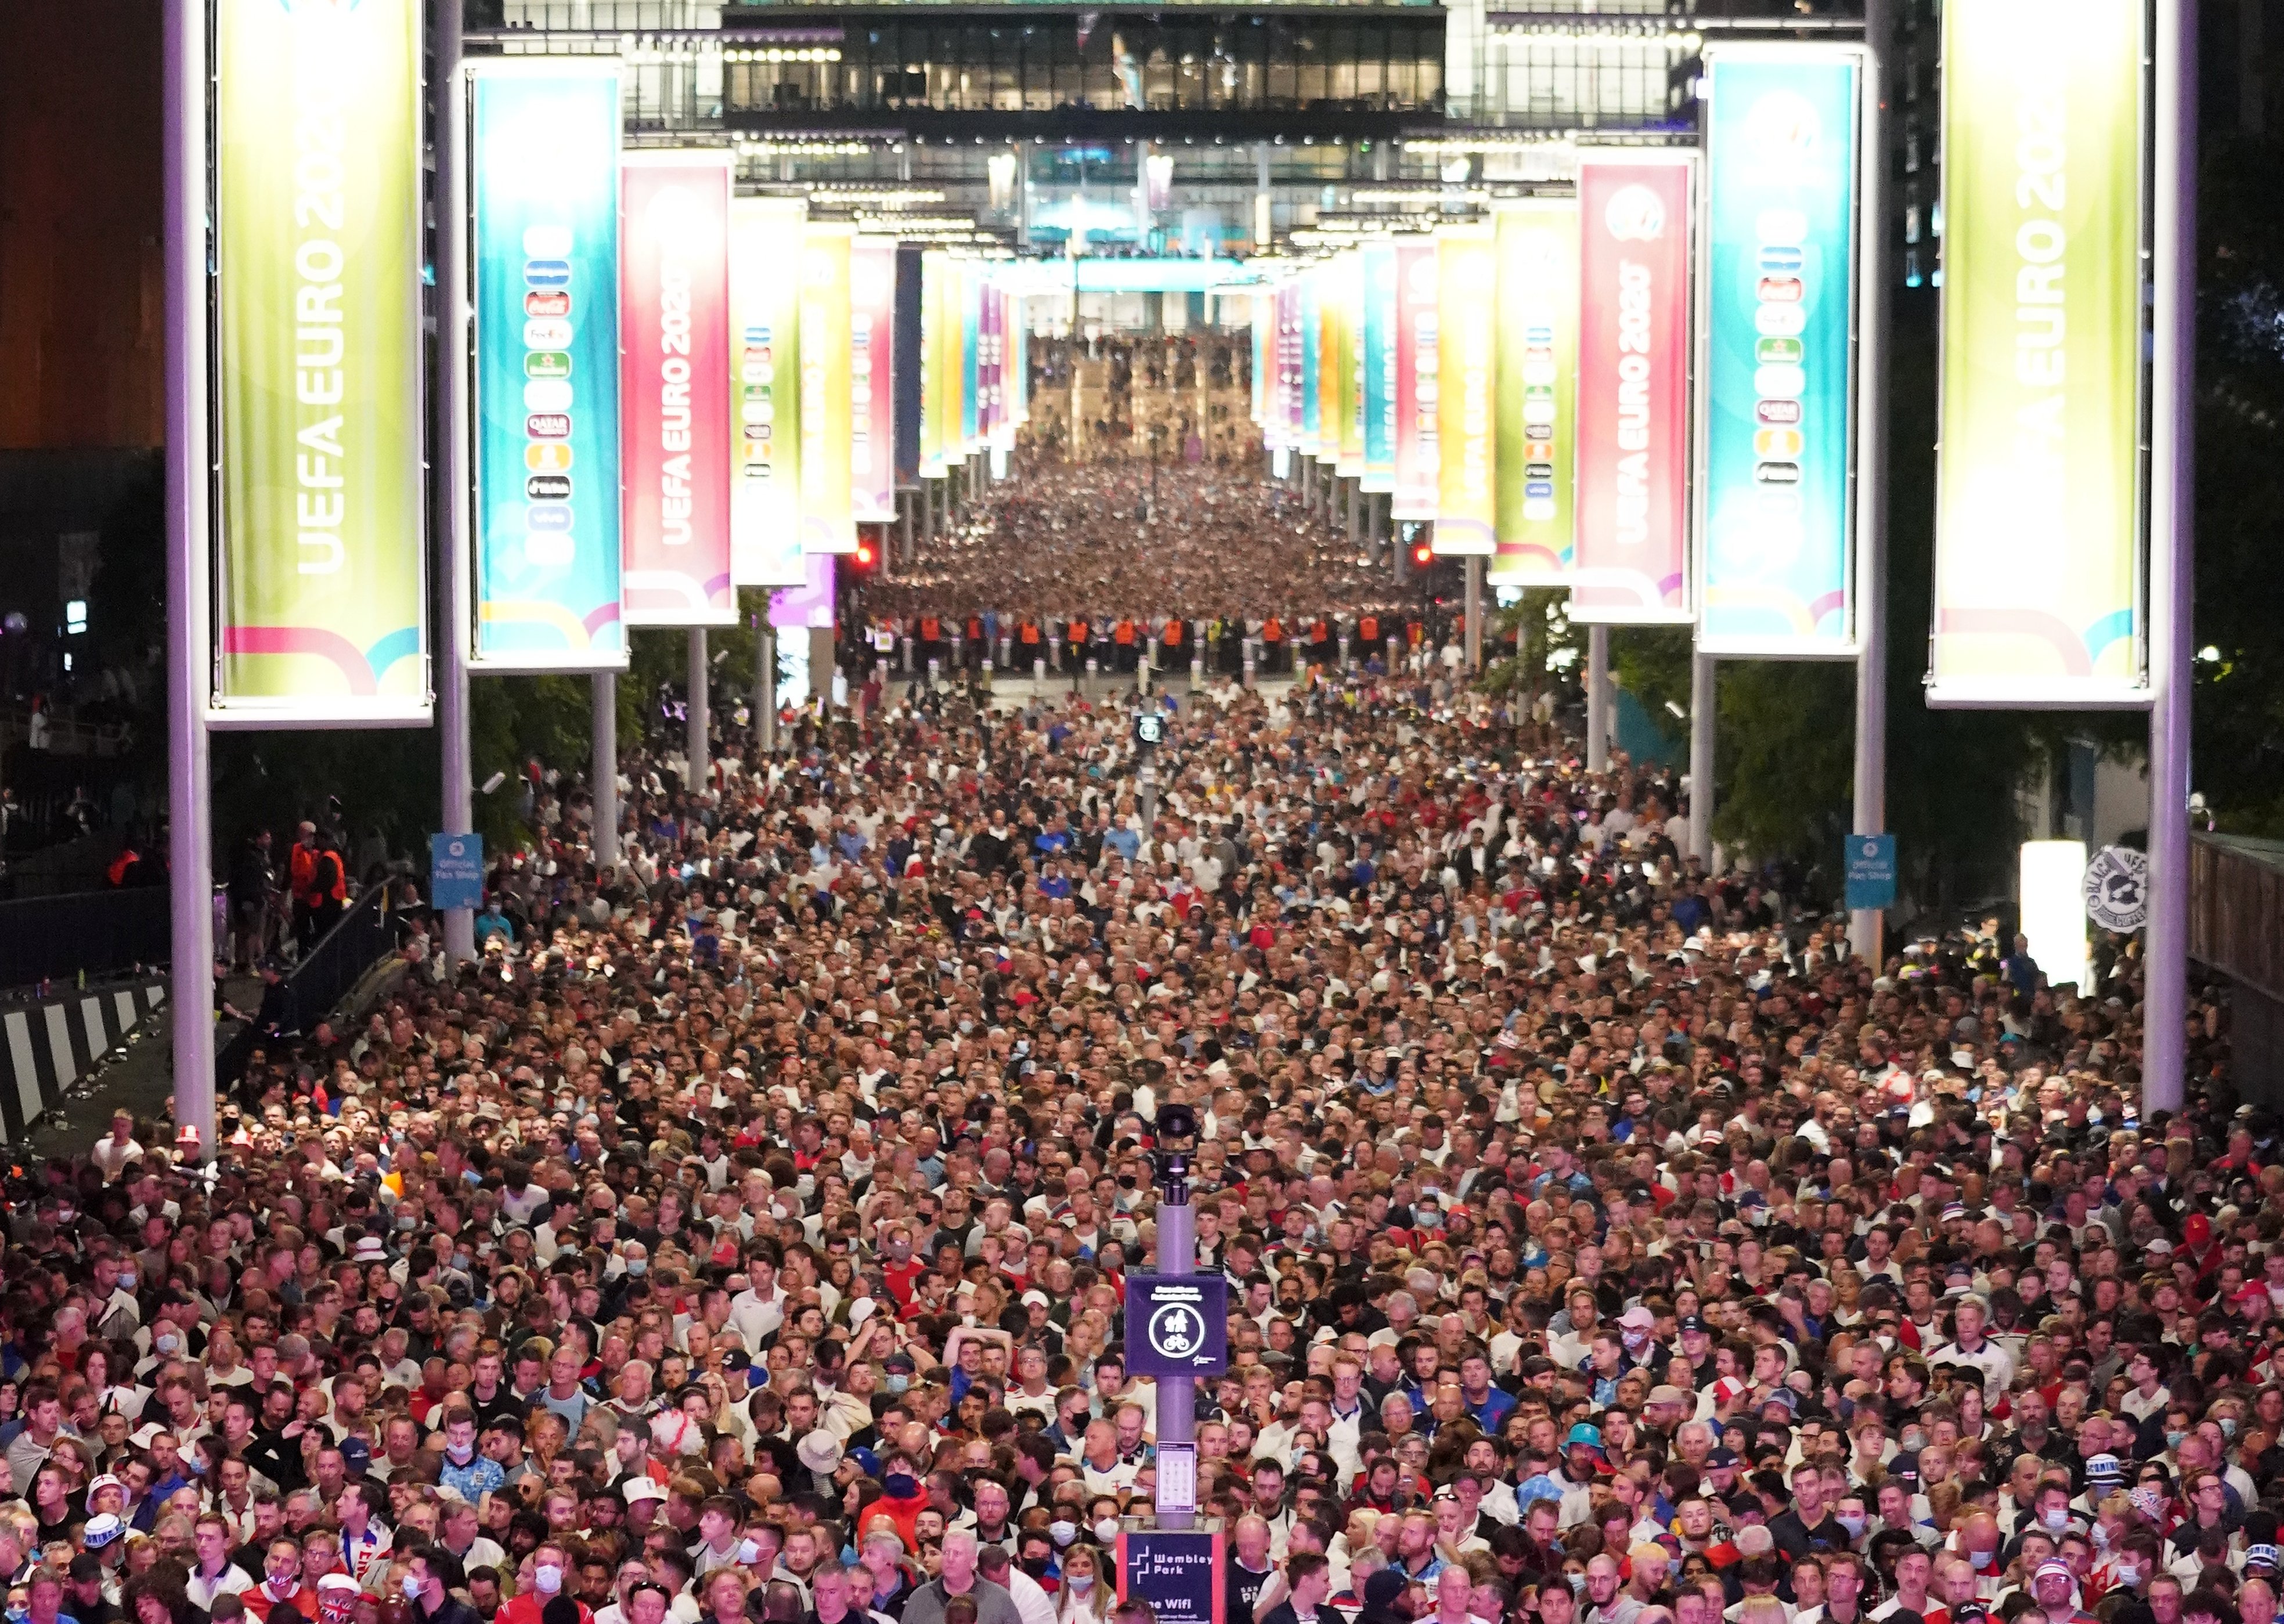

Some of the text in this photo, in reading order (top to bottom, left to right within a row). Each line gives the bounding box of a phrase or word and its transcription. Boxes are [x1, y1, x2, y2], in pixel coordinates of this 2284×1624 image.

[296, 239, 344, 405] EURO
[2015, 219, 2066, 387] EURO
[529, 416, 567, 429] QATAR
[661, 358, 691, 452] EURO
[1617, 355, 1650, 450] EURO
[297, 415, 345, 575] UEFA
[662, 453, 692, 545] UEFA
[1154, 1554, 1213, 1565] Wembley
[1154, 1565, 1184, 1575] Park
[1164, 1598, 1192, 1609] Wifi
